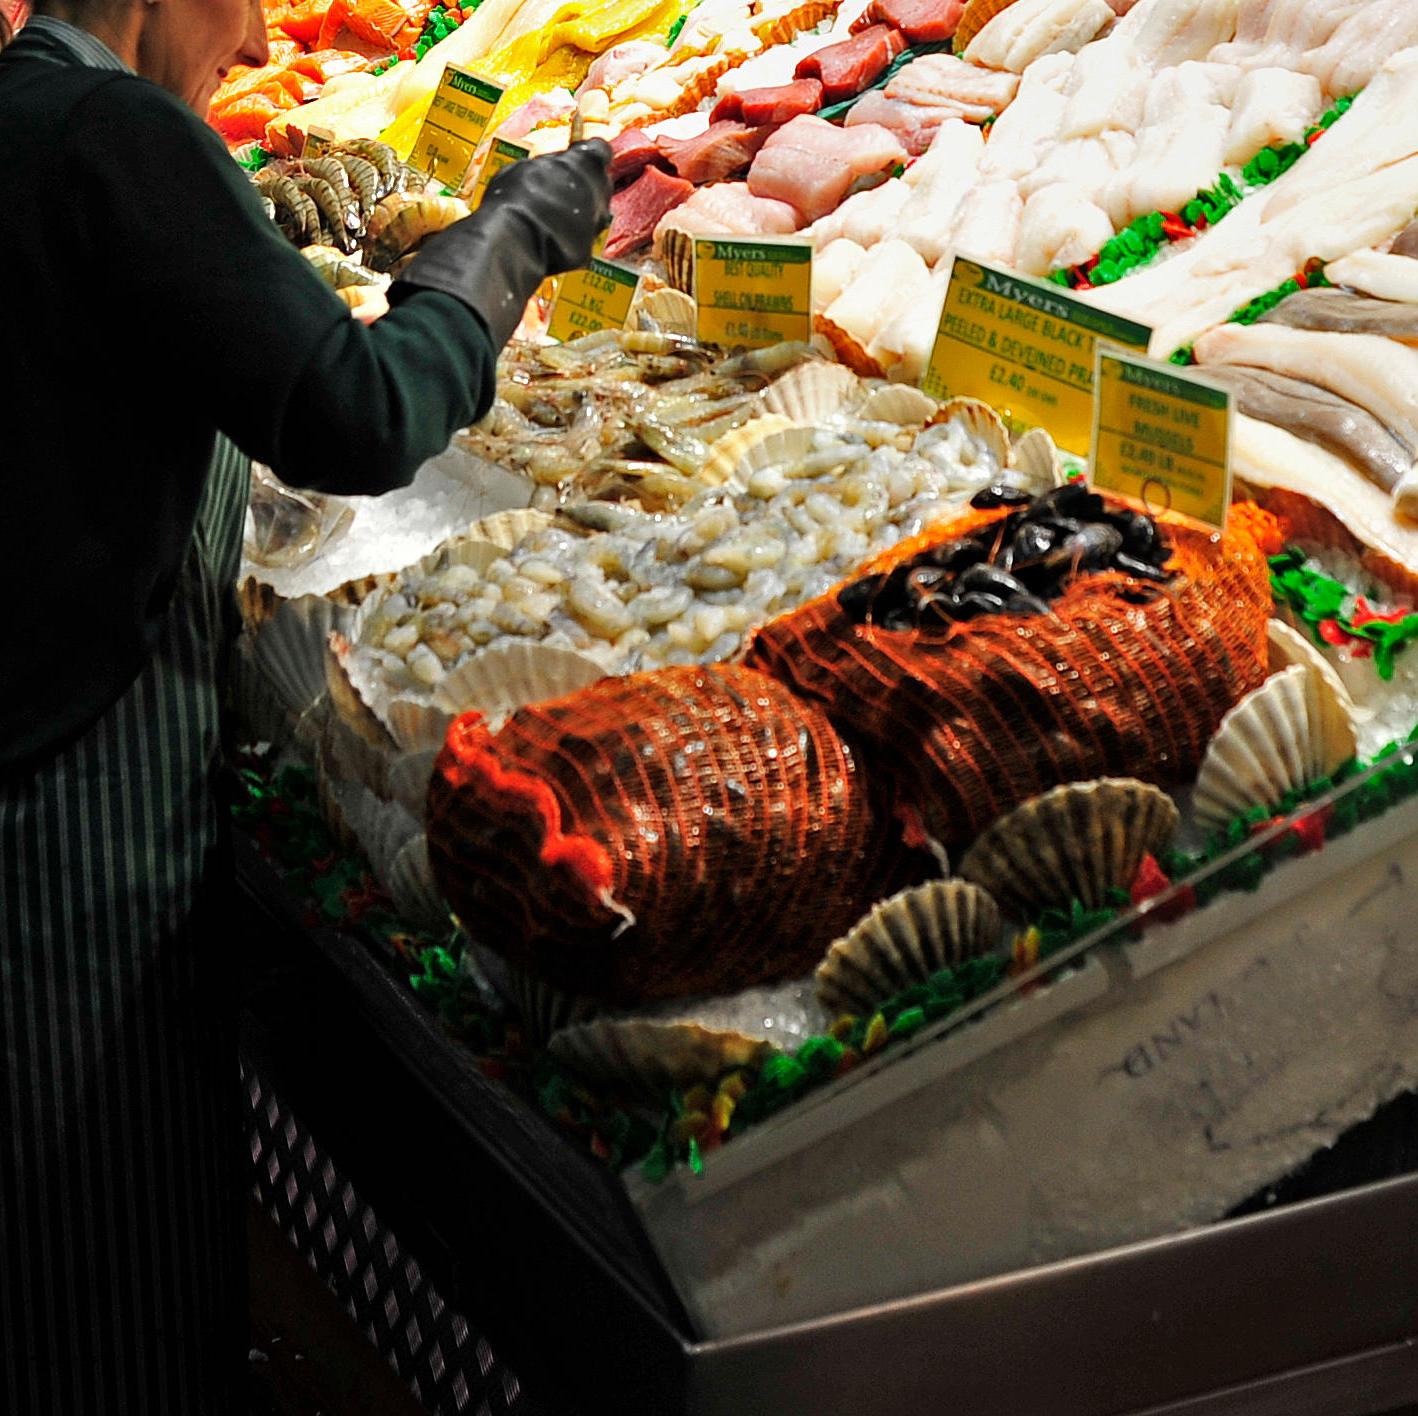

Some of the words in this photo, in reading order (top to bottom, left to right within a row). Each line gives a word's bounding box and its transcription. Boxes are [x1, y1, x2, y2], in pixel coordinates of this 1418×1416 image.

[451, 74, 477, 95] Myers
[717, 245, 766, 260] Myers
[582, 271, 617, 295] £12.00
[724, 260, 745, 276] BEST
[746, 261, 784, 279] QUALITY
[713, 290, 738, 307] SHELL
[754, 293, 794, 312] PRAWNS
[985, 273, 1070, 320] Myers
[958, 286, 996, 314] EXTRA
[998, 301, 1037, 330] LARGE
[1041, 314, 1083, 348] BLACK
[944, 312, 985, 342] PEELED
[989, 331, 997, 347] &
[999, 335, 1067, 377] DEVEINED
[1067, 363, 1094, 385] PRA
[989, 363, 1026, 392] £2.40
[1123, 364, 1183, 394] Myers
[1129, 392, 1170, 416] FRESH
[1173, 408, 1199, 430] LIVE
[1133, 420, 1195, 456] MUSSELS
